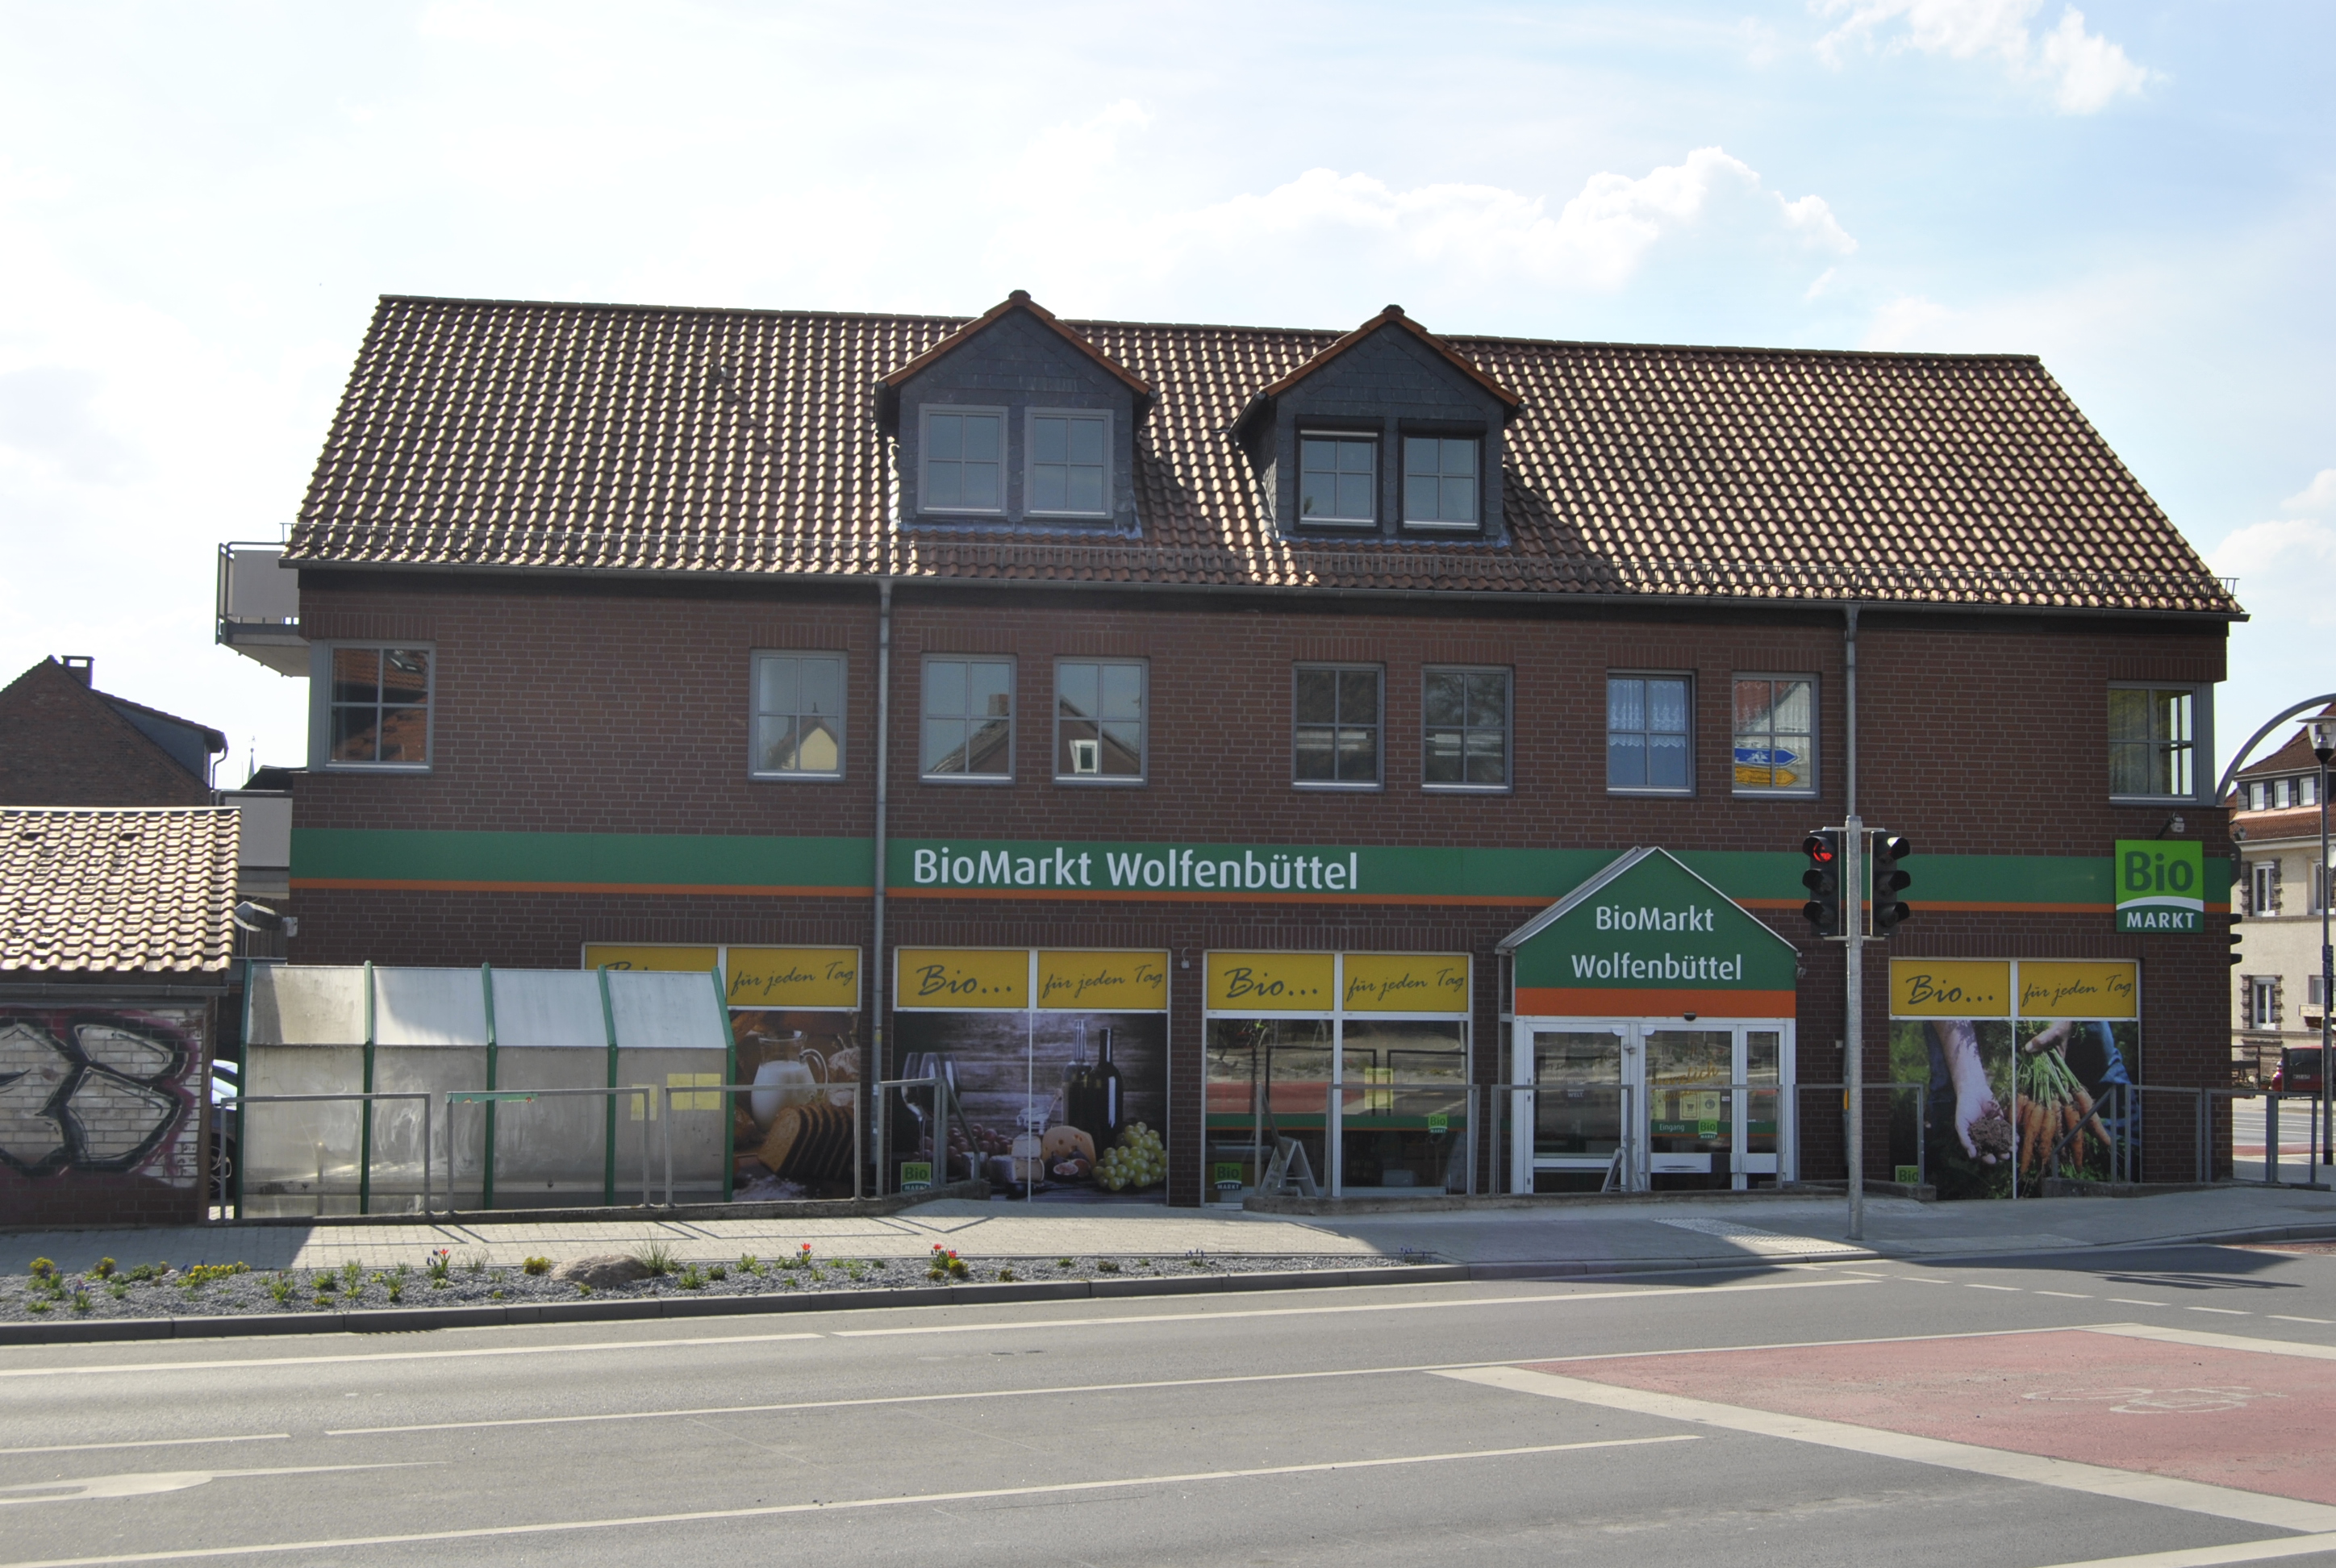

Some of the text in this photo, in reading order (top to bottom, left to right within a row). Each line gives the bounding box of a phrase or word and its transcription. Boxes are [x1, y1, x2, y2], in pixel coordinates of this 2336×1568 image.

[914, 847, 1357, 889] BioMarkt Wolfenbüttel
[2125, 850, 2194, 892] Bio
[1596, 905, 1714, 932] BioMarkt
[2126, 912, 2194, 928] MARKT
[731, 961, 854, 996] für jeden Tag
[1571, 952, 1742, 980] Wolfenbüttel
[916, 964, 1163, 999] Bio... für jeden Tag
[1224, 967, 1465, 1002] Bio... für jeden Tag
[1905, 974, 2132, 1007] Bio... für jeden Tag
[1430, 1116, 1446, 1126] Bio
[1659, 1124, 1685, 1132] Eingang
[1700, 1122, 1716, 1131] Bio
[905, 1166, 928, 1179] Bio
[1217, 1166, 1240, 1178] Bio
[1899, 1170, 1919, 1182] Bio
